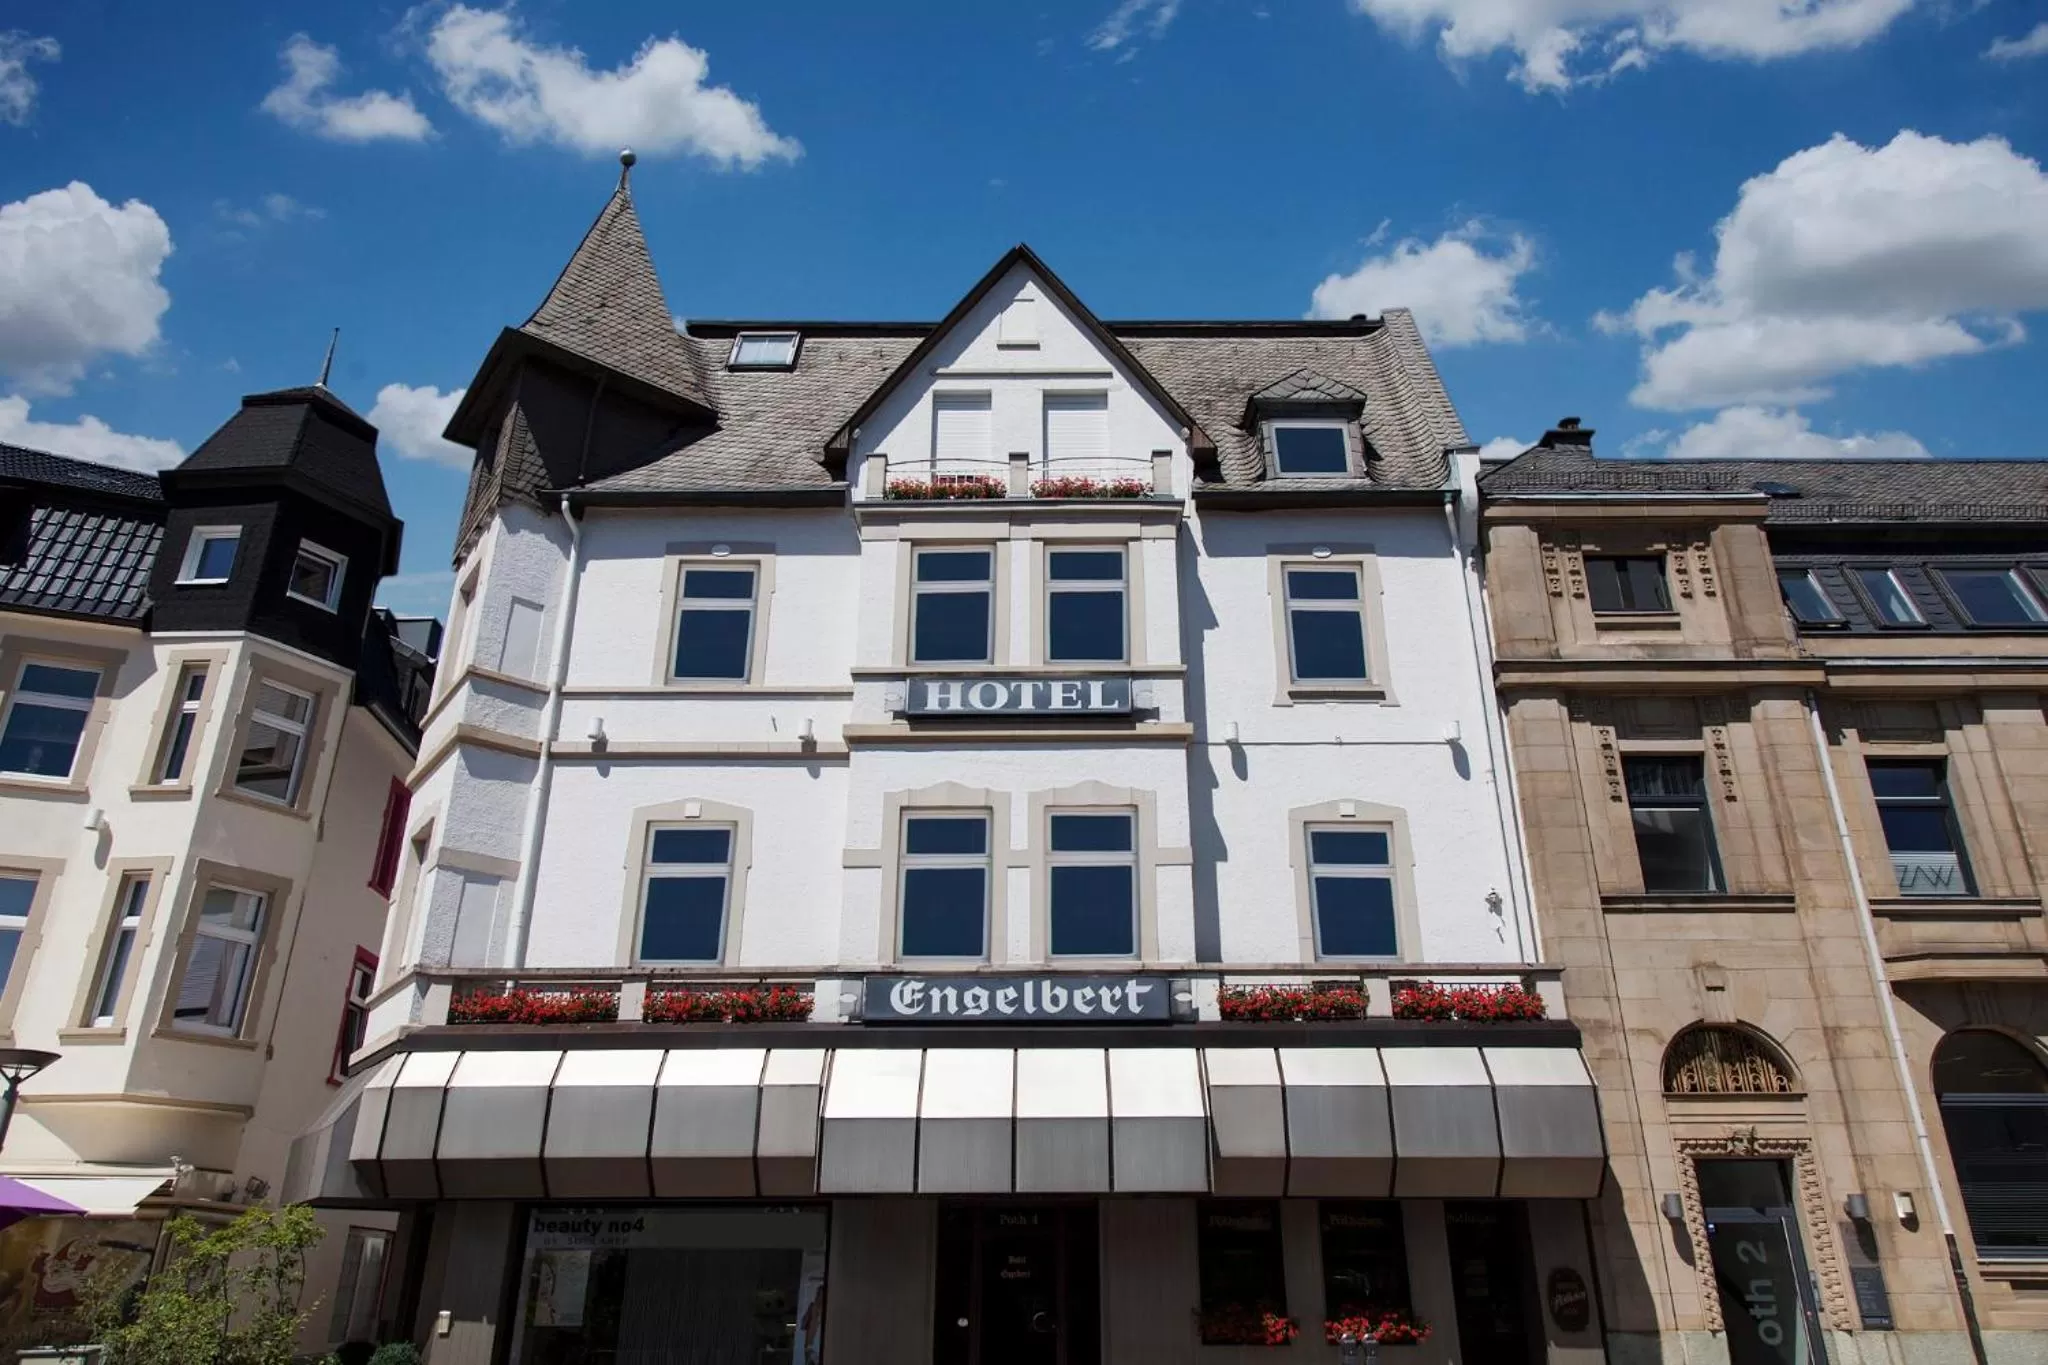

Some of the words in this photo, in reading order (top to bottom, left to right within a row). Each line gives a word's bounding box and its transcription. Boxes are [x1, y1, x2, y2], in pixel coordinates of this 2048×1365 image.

[924, 680, 1119, 712] HOTEL
[889, 978, 1154, 1016] Engelbert
[534, 1217, 603, 1236] beauty
[608, 1216, 645, 1233] no4
[1736, 1240, 1768, 1264] 2
